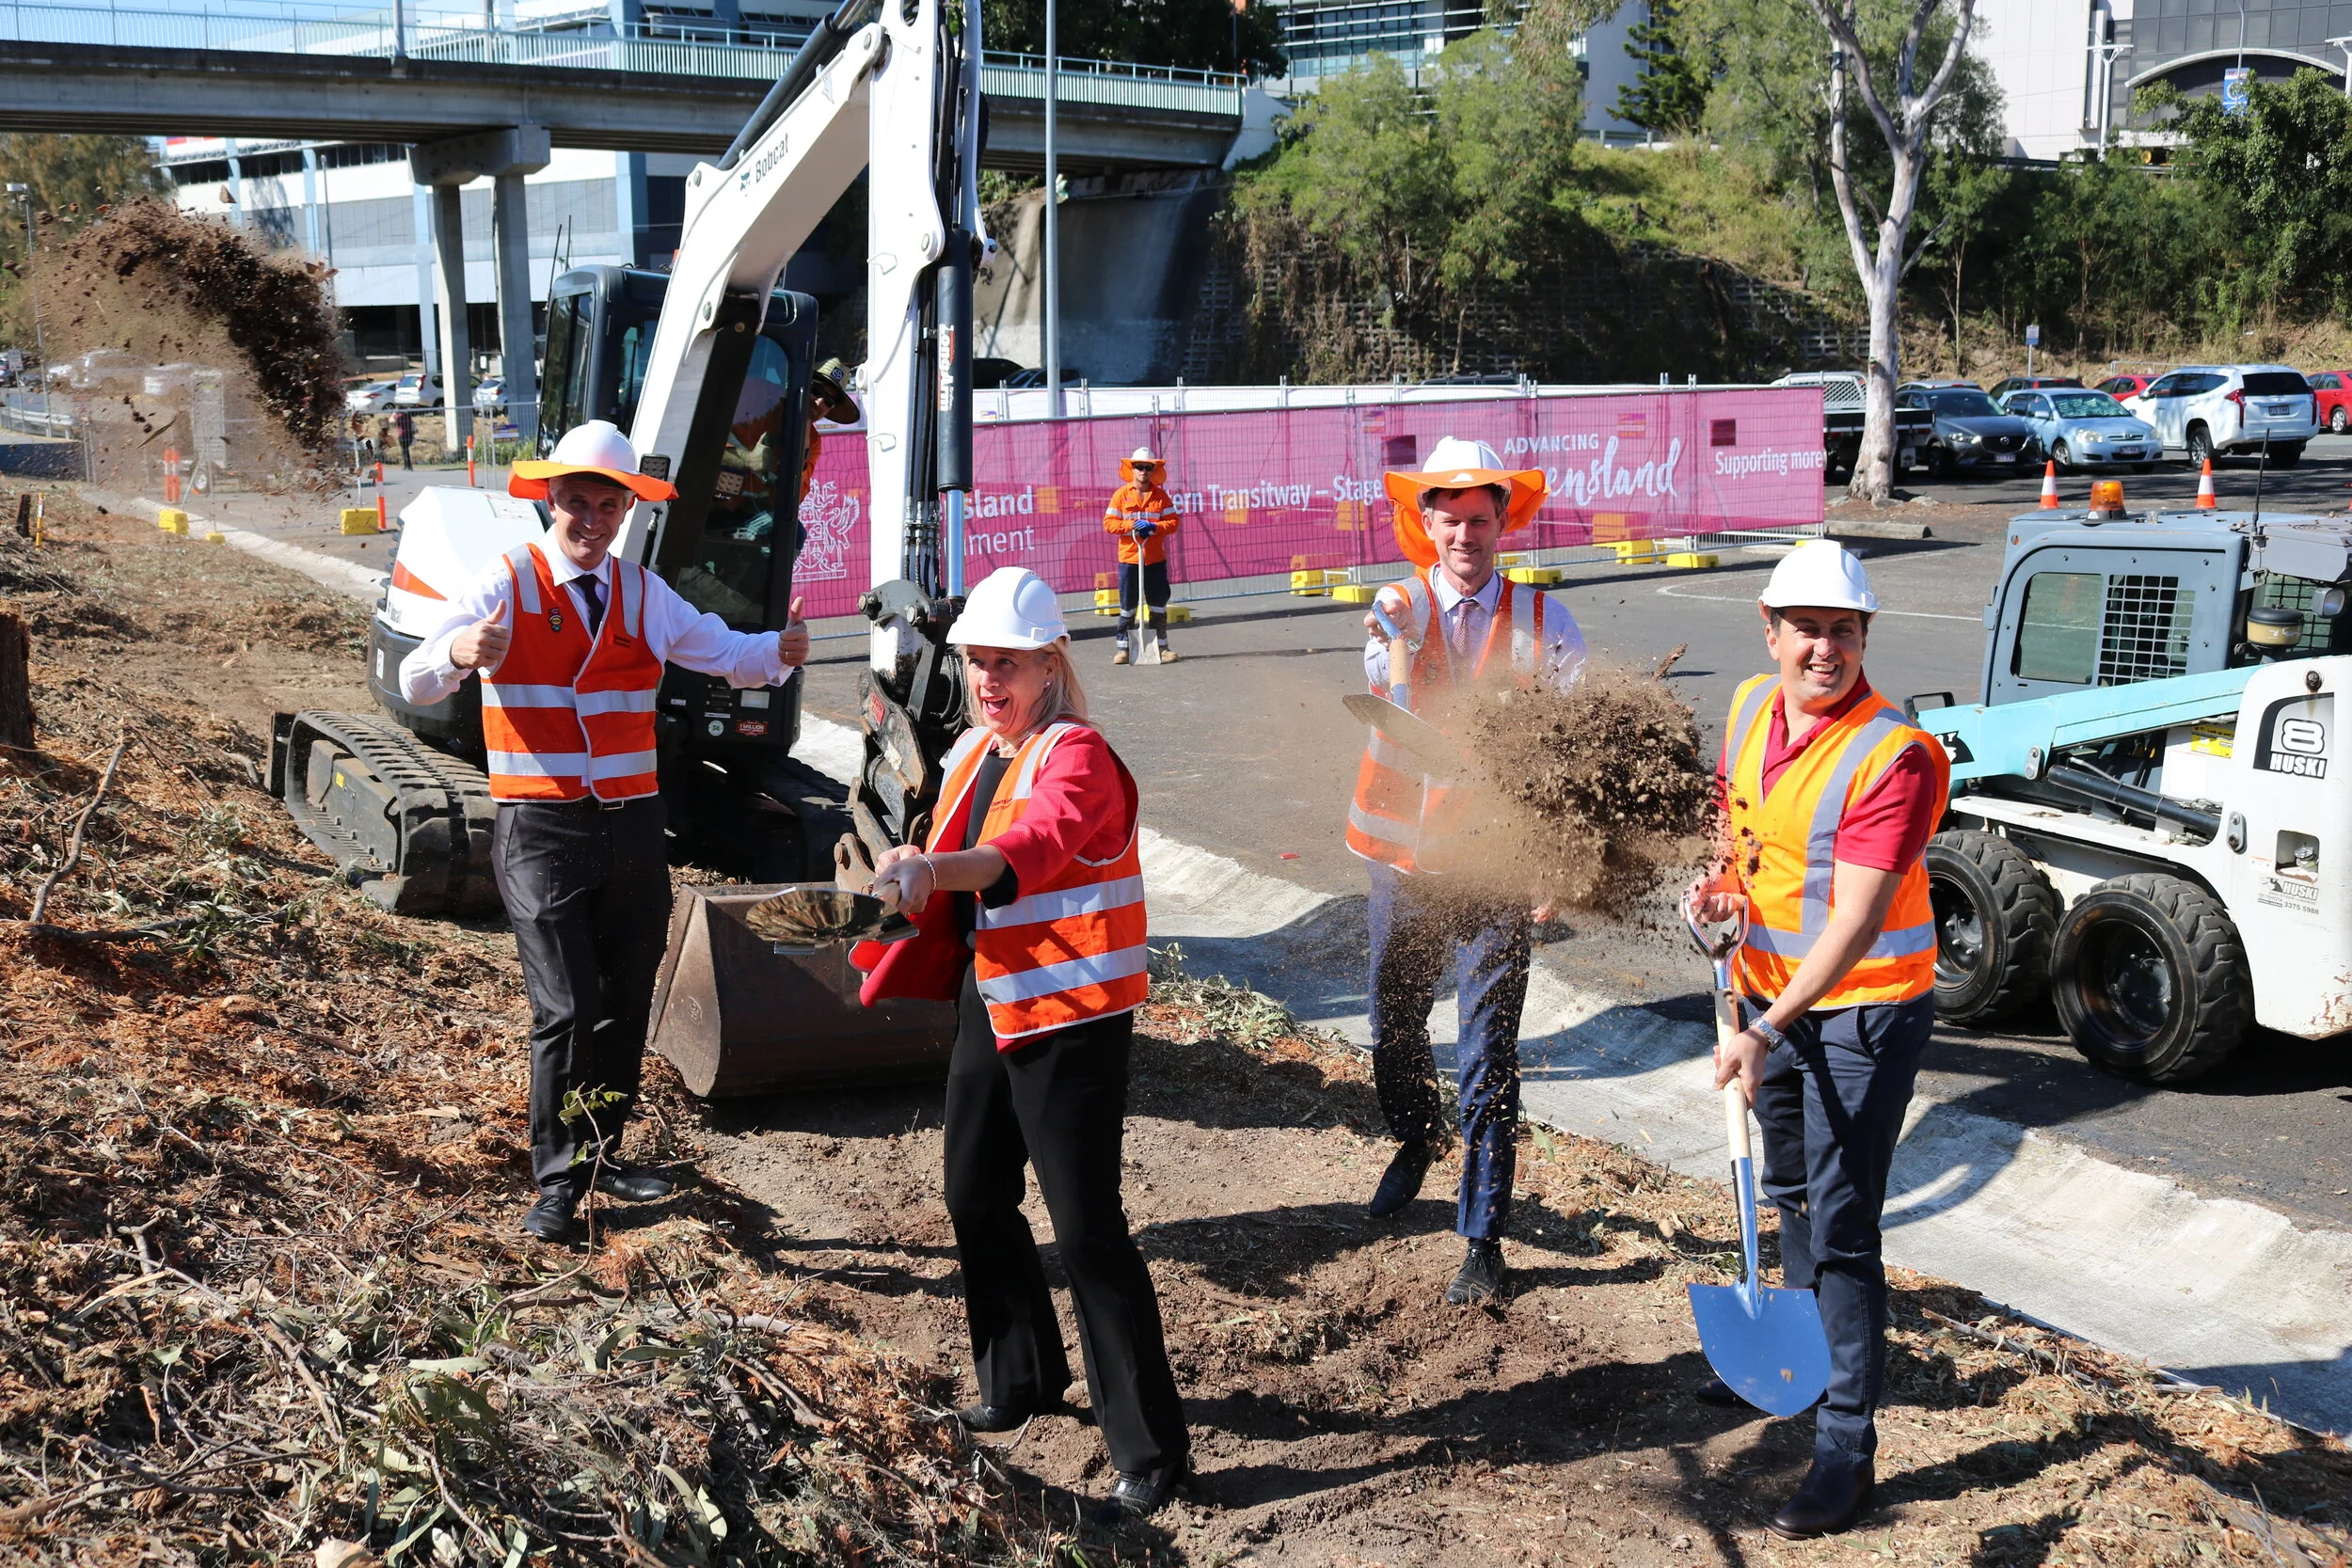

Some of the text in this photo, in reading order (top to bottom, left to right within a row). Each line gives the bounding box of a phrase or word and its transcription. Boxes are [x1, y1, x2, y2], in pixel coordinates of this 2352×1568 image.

[755, 133, 788, 183] Bobcat
[940, 324, 955, 411] LongArm
[1503, 434, 1599, 454] ADVANCING
[1543, 436, 1678, 506] ensland
[1715, 448, 1823, 481] Supporting more
[1208, 480, 1311, 512] Transitway
[1333, 474, 1383, 506] Stage
[2281, 718, 2325, 755] 8
[2268, 752, 2326, 779] HUSKI
[2282, 880, 2319, 901] HUSKI
[2283, 901, 2300, 911] 3375
[2302, 906, 2319, 915] 5988
